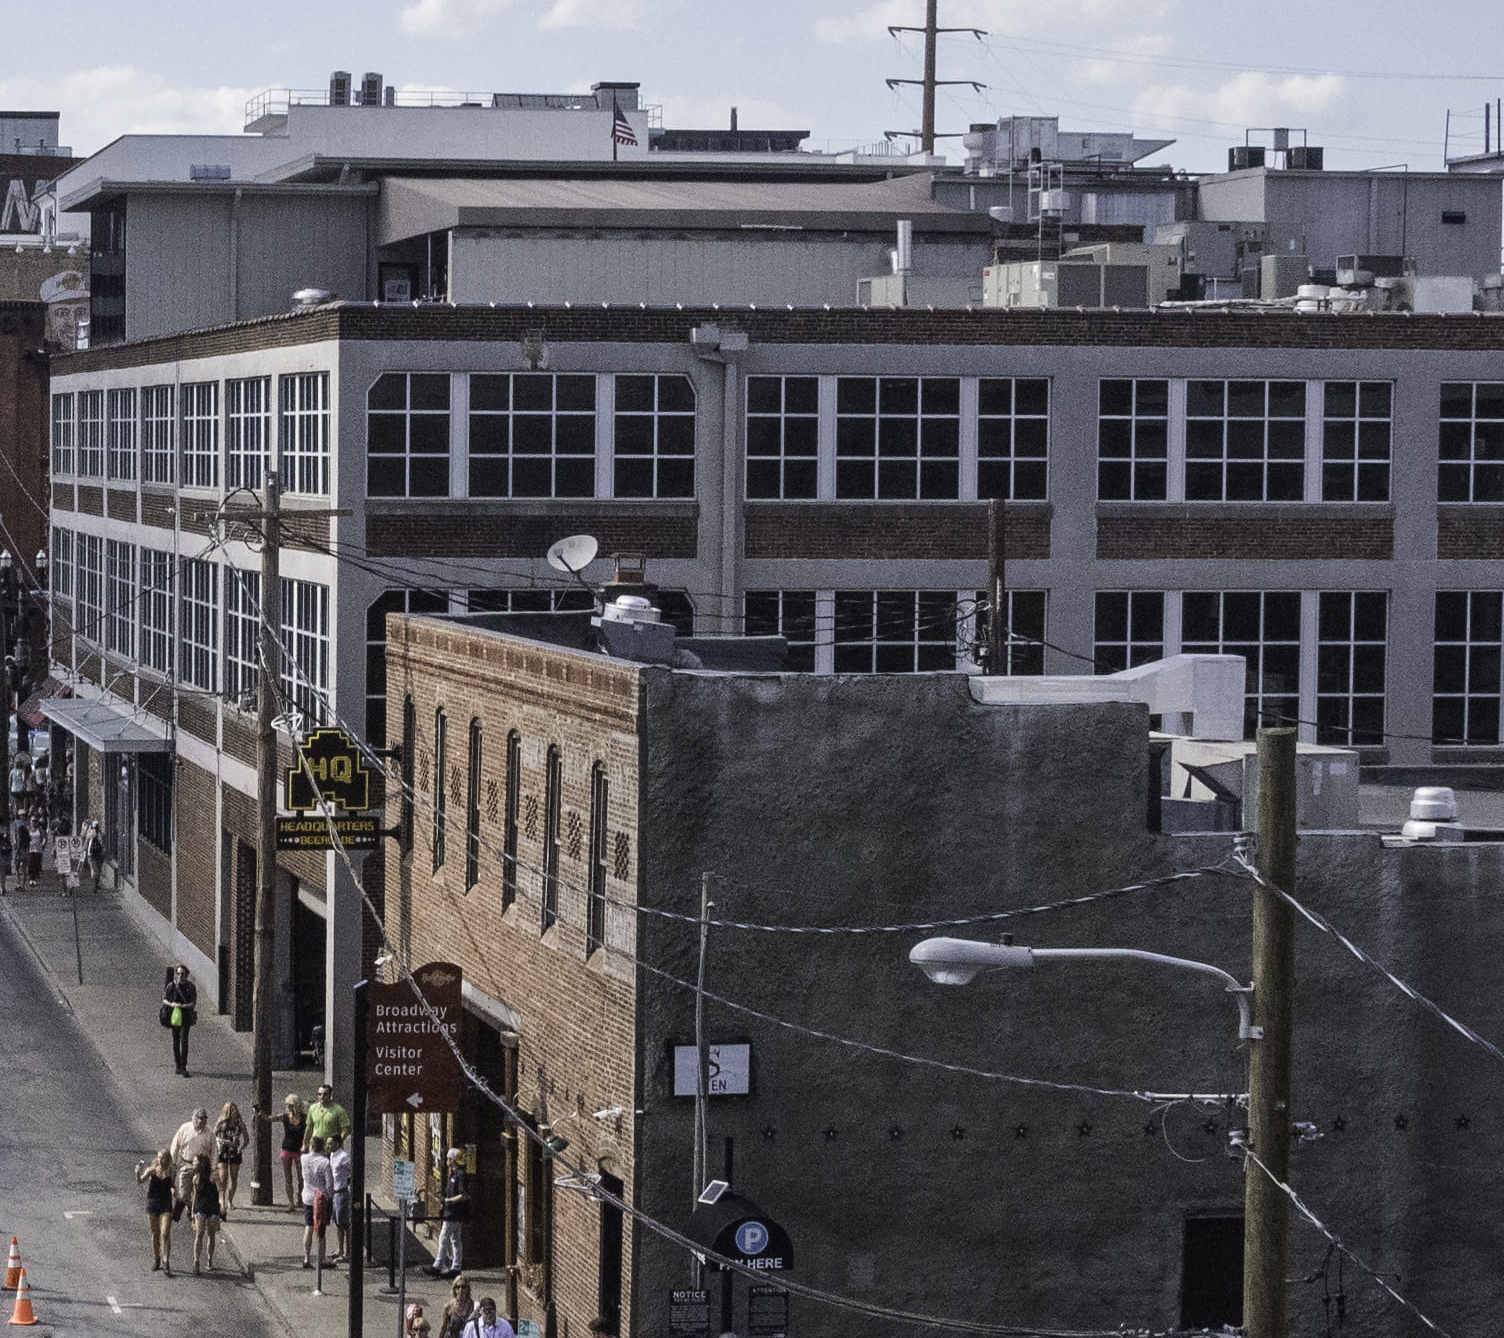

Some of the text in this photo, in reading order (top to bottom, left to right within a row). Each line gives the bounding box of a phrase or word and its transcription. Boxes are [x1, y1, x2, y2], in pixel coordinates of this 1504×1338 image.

[307, 755, 352, 783] HQ
[279, 820, 375, 832] HEADQUARTERS
[300, 835, 356, 845] BEERDE
[376, 1004, 447, 1019] Broadway
[376, 1021, 457, 1034] Attractions
[375, 1045, 423, 1059] Visitor
[375, 1063, 423, 1076] Center
[747, 1257, 783, 1270] HERE
[672, 1290, 706, 1299] NOTICE
